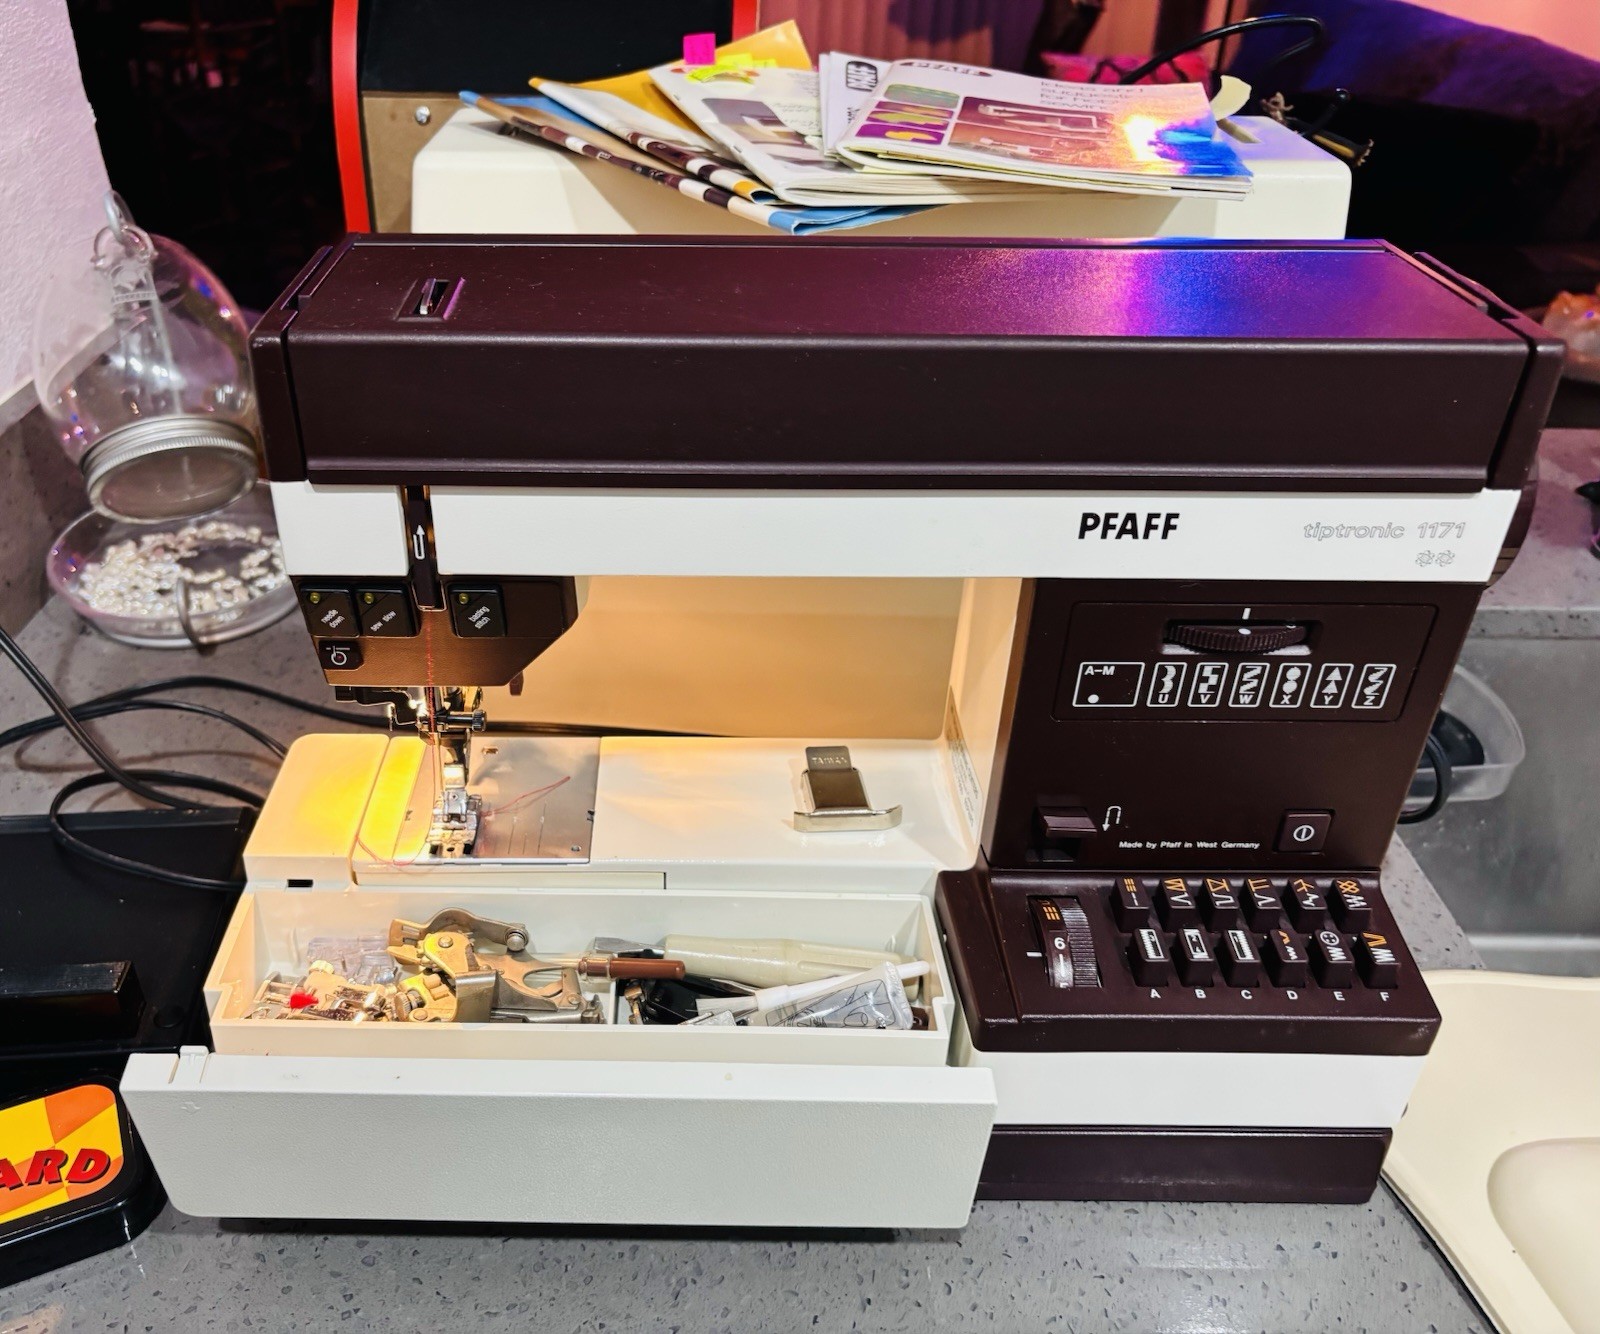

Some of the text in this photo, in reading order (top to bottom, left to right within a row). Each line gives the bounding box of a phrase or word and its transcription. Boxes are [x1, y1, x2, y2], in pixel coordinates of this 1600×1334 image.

[1078, 512, 1180, 540] PFAFF
[1303, 521, 1466, 541] tiptronic 1171
[1084, 665, 1115, 676] A-M
[1157, 694, 1169, 704] U
[1200, 694, 1211, 704] V
[1239, 694, 1254, 704] W
[1280, 695, 1291, 704] X
[1322, 695, 1334, 705] Y
[1364, 695, 1374, 706] Z
[1119, 840, 1143, 848] Made
[1146, 840, 1157, 849] by
[1160, 840, 1182, 848] Pfaff
[1221, 841, 1260, 849] Germany
[1054, 937, 1066, 950] 6
[1150, 988, 1161, 999] A
[1195, 989, 1207, 999] B
[1240, 989, 1252, 1000] C
[1286, 990, 1298, 1000] D
[1333, 991, 1345, 1001] E
[1379, 991, 1390, 1001] F
